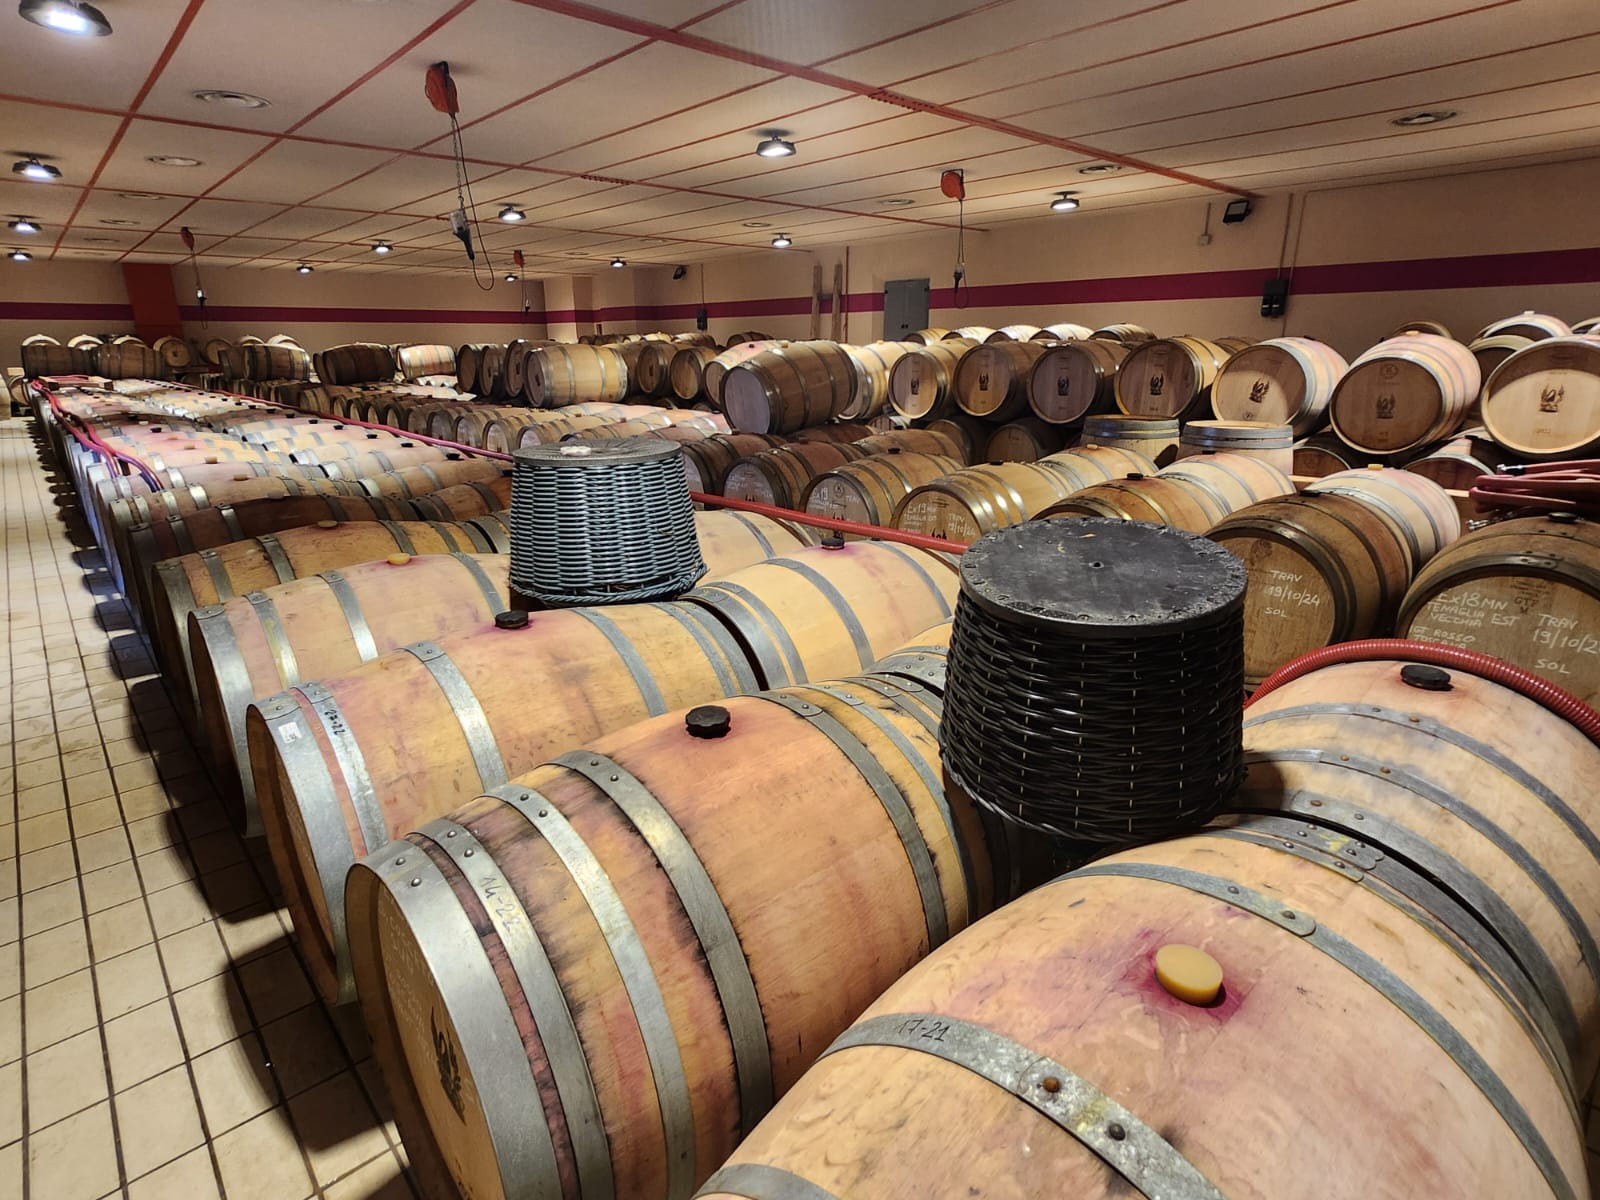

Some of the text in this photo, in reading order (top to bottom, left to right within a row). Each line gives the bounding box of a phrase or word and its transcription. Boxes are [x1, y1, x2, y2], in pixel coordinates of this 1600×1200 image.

[1270, 569, 1303, 582] TRAV
[1267, 584, 1321, 607] 19/10/24
[1264, 606, 1288, 618] SOL
[1427, 602, 1521, 627] TENAGLIA EST
[1430, 612, 1483, 628] VECCHIA
[1537, 612, 1579, 631] TRAV
[1433, 629, 1476, 643] ROSSO
[1532, 628, 1600, 655] 19/10/2
[1534, 658, 1571, 675] SOL
[896, 1018, 950, 1042] 17-21
